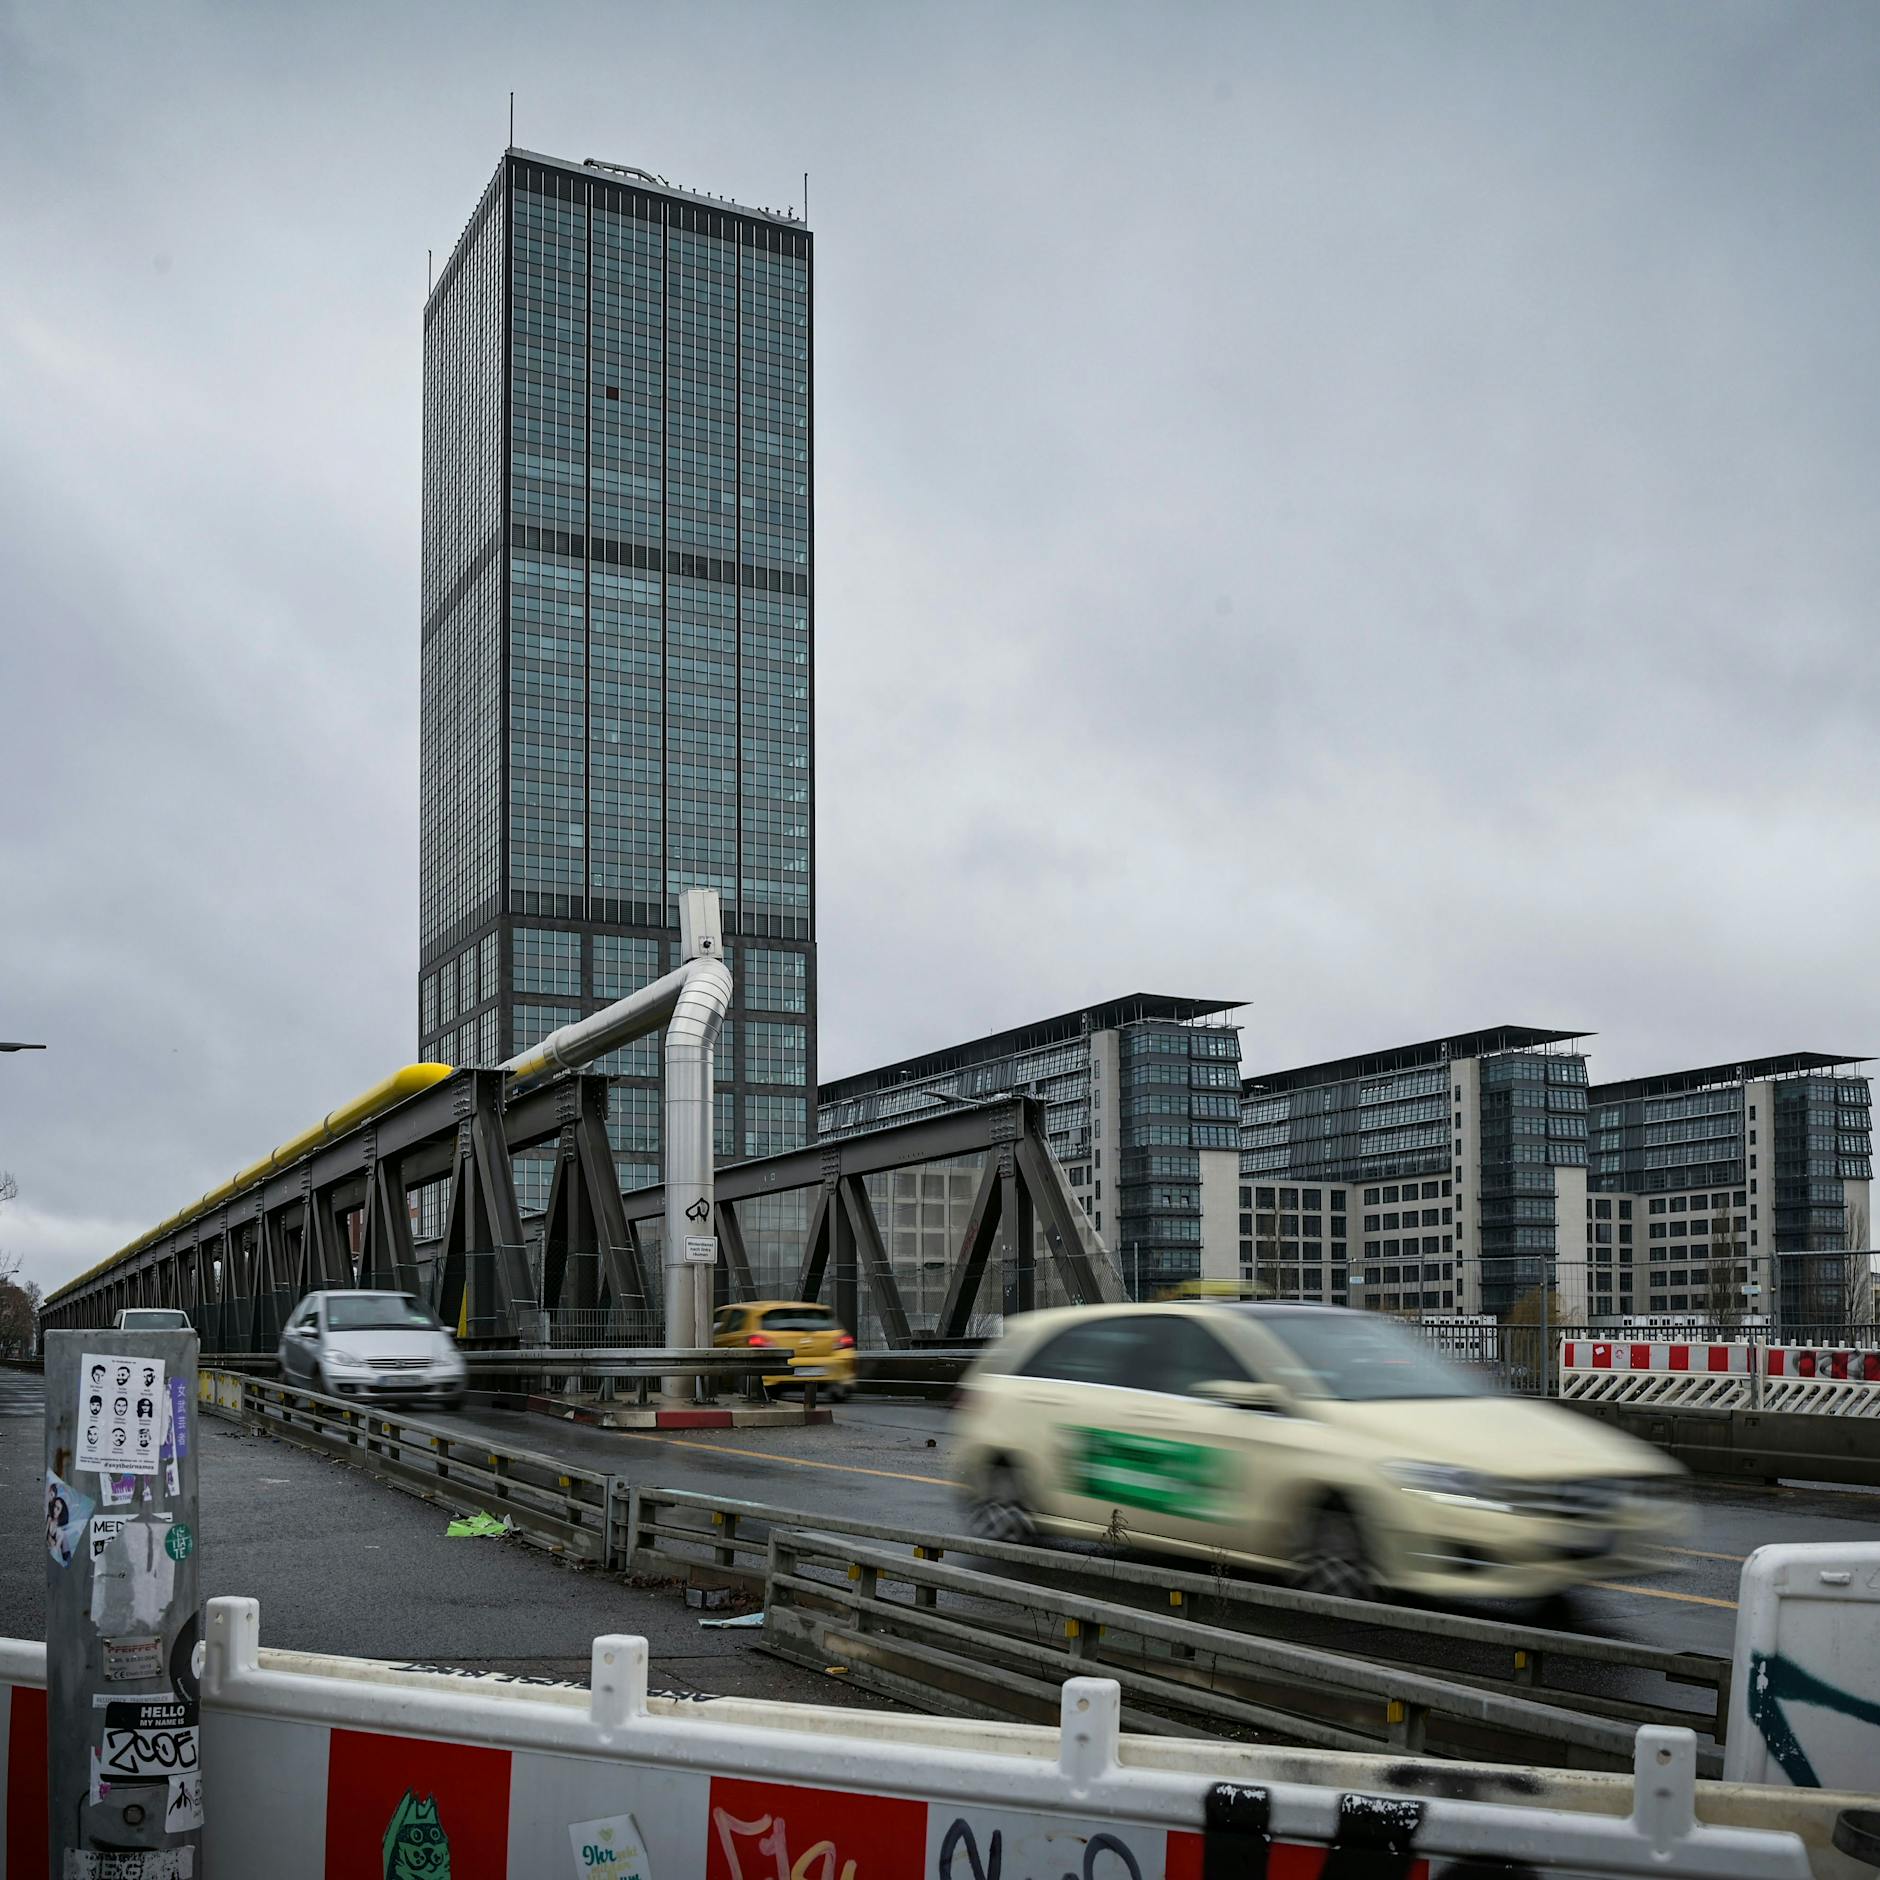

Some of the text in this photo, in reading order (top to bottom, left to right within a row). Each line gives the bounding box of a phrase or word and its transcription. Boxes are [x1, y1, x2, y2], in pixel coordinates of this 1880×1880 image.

[141, 1706, 186, 1718] HELLO
[140, 1719, 154, 1727] MY
[154, 1719, 177, 1727] NAME
[582, 1845, 617, 1866] Ihr
